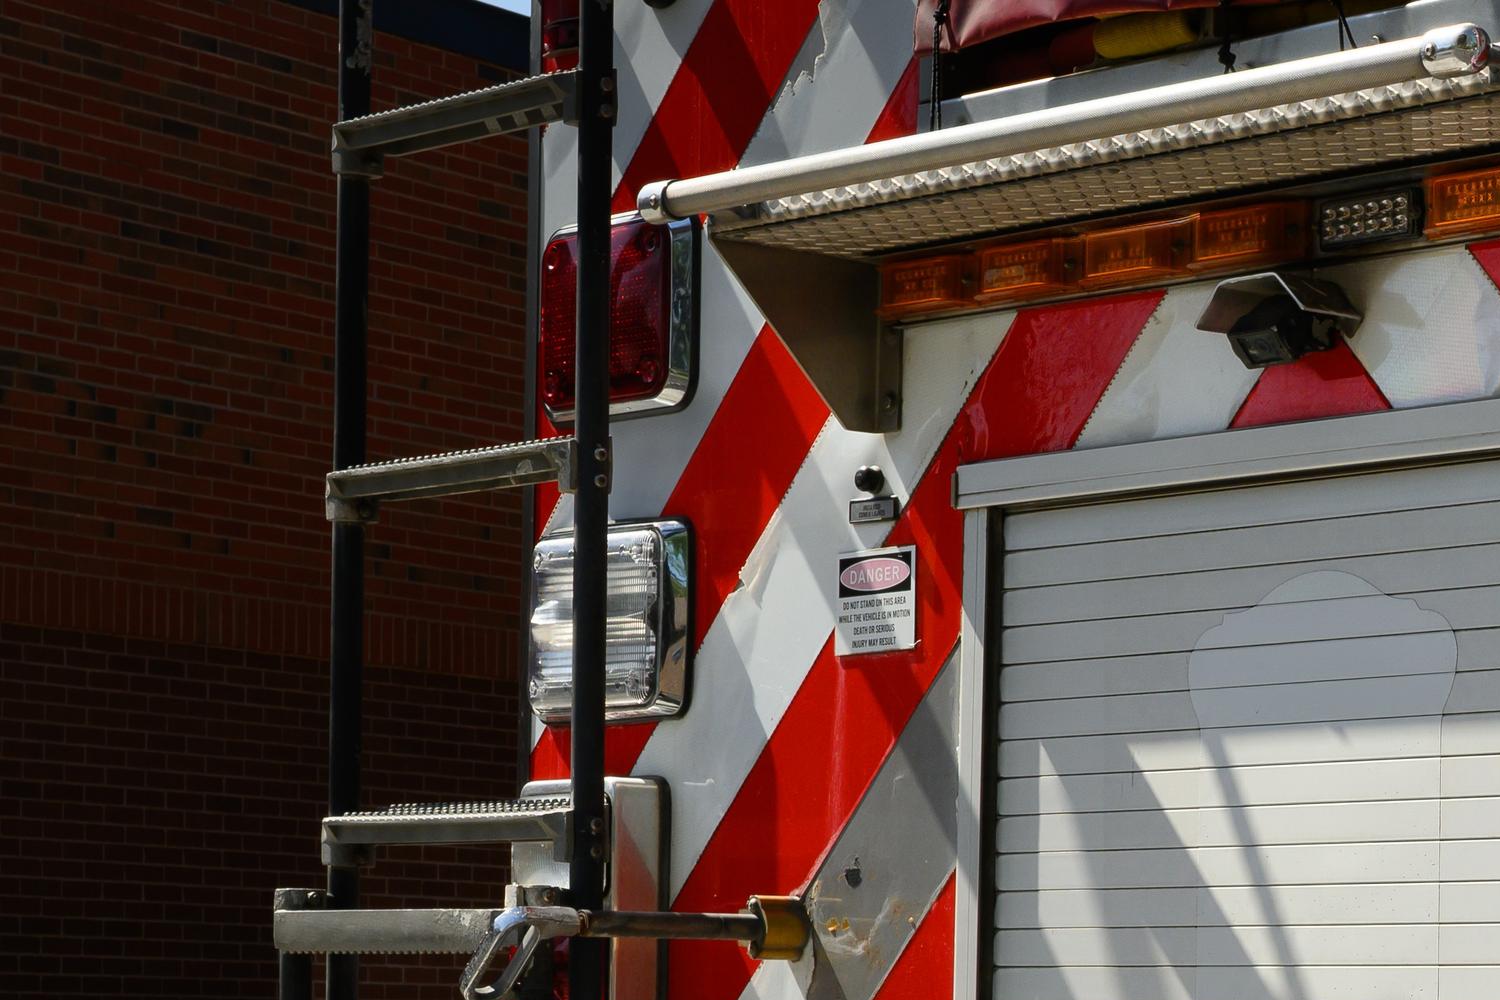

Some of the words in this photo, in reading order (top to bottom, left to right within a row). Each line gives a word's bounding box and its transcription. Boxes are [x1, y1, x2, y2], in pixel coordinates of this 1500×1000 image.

[849, 566, 900, 585] DANGER
[843, 602, 850, 611] DO
[850, 601, 860, 609] NOT
[860, 599, 875, 608] STAND
[875, 598, 882, 607] ON
[883, 597, 894, 606] THIS
[894, 596, 906, 605] AREA
[839, 614, 853, 623] WHILE
[853, 613, 862, 622] THE
[862, 612, 881, 621] VEHICLE
[881, 611, 886, 619] IS
[893, 609, 911, 618] MOTION
[853, 626, 868, 635] DEATH
[868, 625, 875, 634] OR
[875, 623, 895, 633] SERIOUS
[851, 638, 868, 648] INJURY
[868, 637, 879, 646] MAY
[879, 636, 896, 646] RESULT
